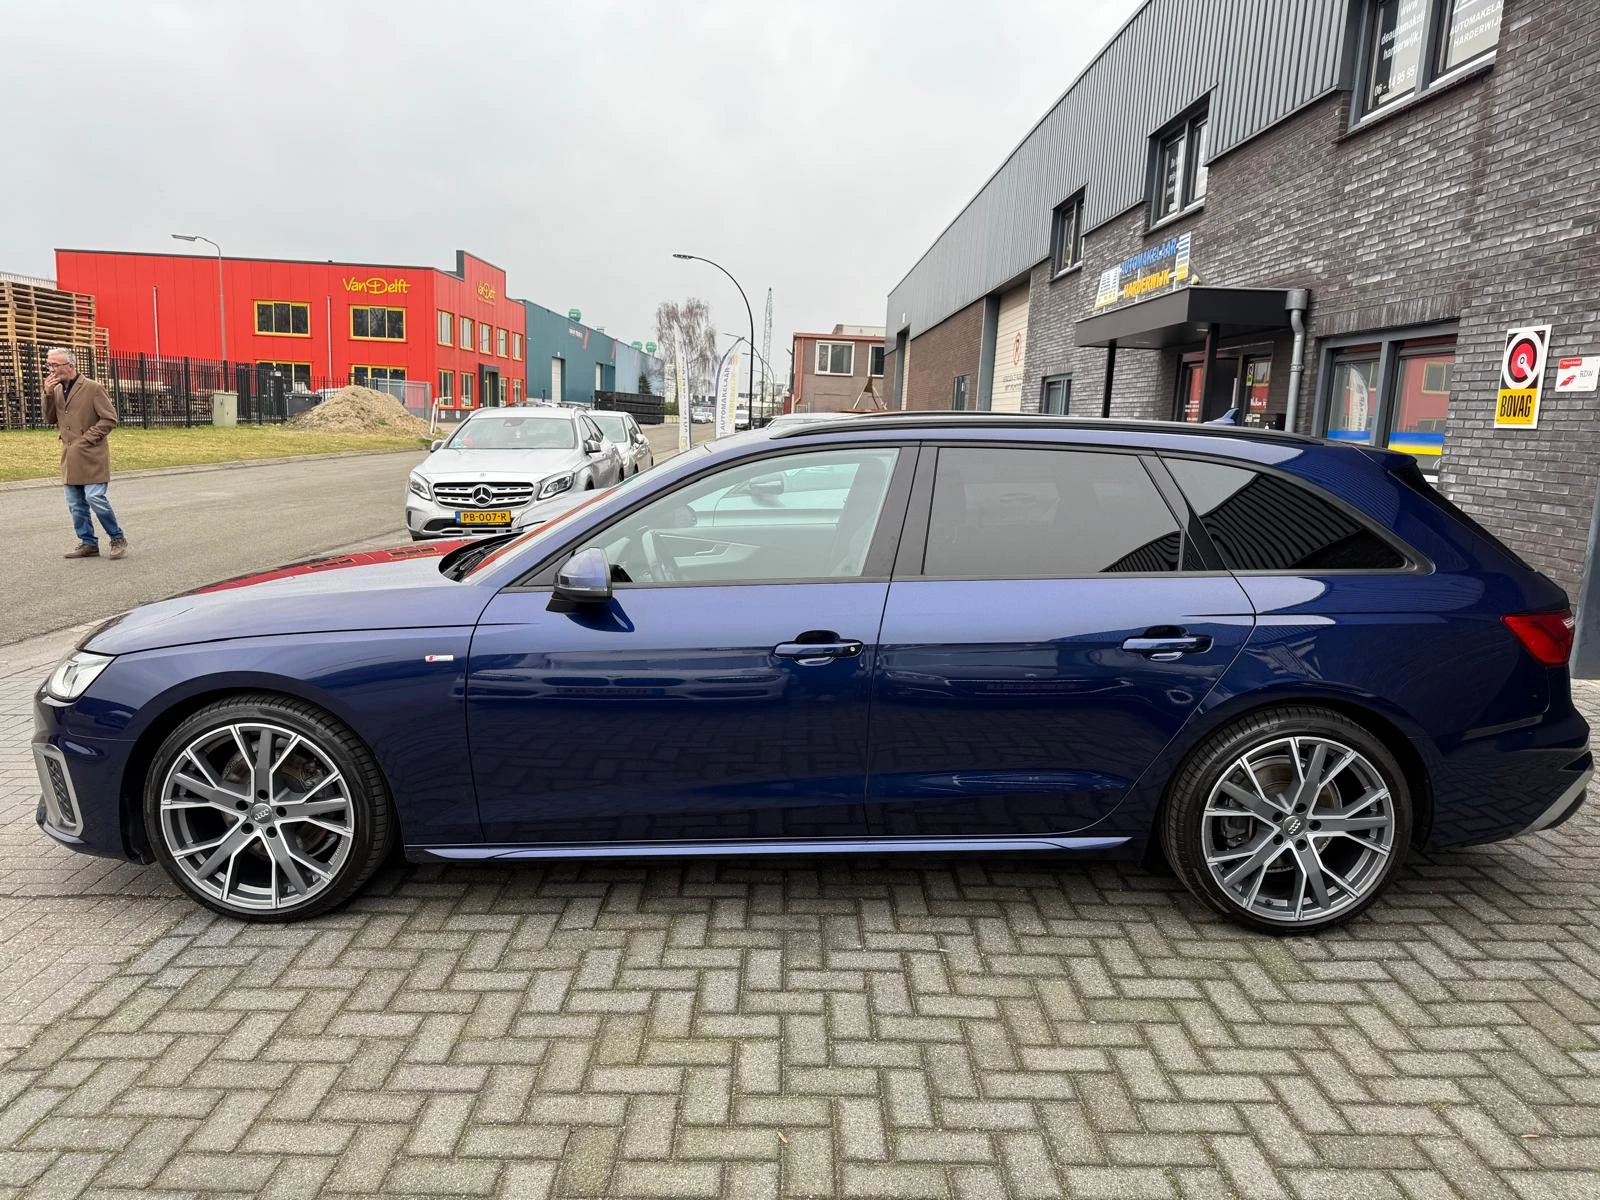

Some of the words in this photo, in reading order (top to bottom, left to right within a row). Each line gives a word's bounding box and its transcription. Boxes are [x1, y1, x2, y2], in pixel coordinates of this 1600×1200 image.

[1381, 9, 1425, 46] deautomakel
[1450, 0, 1504, 36] AUTOMAKELA
[1383, 29, 1423, 61] harderwijk.
[1121, 238, 1177, 275] AUTOMAKELAAR
[1123, 268, 1170, 299] HARDERWIJK
[719, 367, 731, 431] AUTOMAKELAAR
[1500, 394, 1532, 418] BOVAG
[463, 513, 507, 522] PB-007-R
